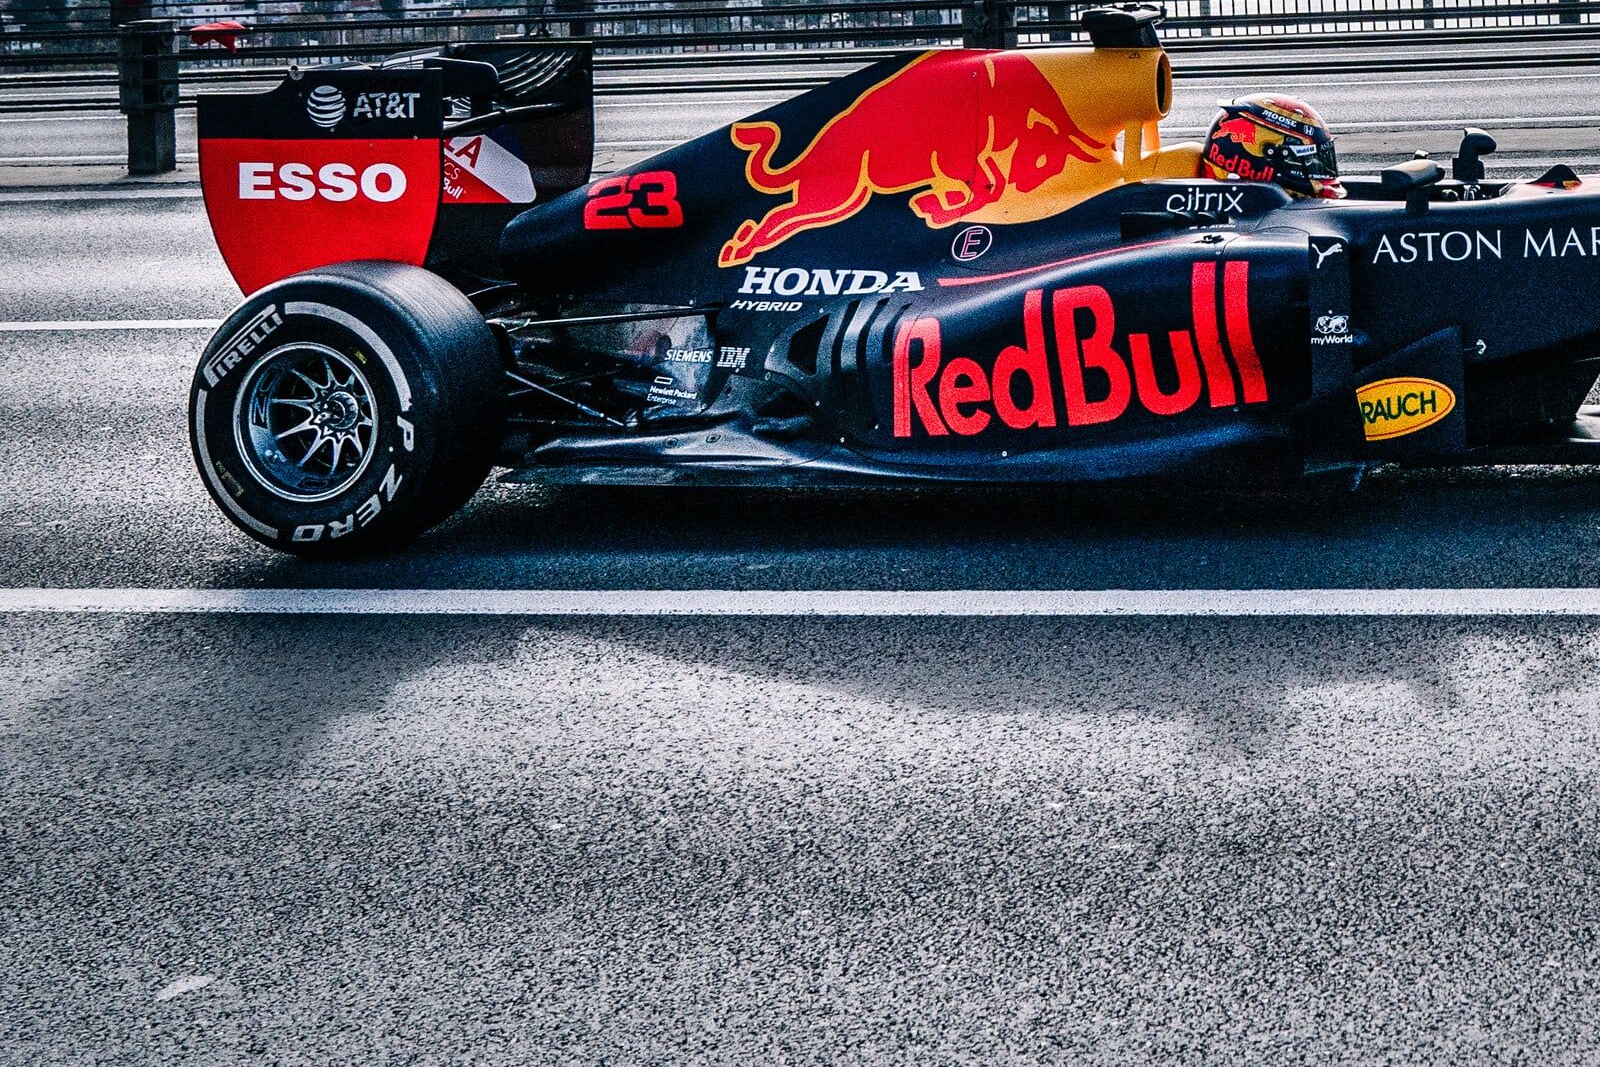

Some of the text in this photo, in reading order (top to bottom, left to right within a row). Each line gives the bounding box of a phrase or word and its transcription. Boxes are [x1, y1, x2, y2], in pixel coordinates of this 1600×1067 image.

[353, 92, 420, 119] AT&T
[1261, 110, 1298, 128] MOOSE
[238, 162, 407, 202] ESSO
[583, 171, 684, 229] 23
[1166, 186, 1244, 212] citrix
[1372, 230, 1502, 264] ASTON
[737, 266, 925, 296] HONDA
[730, 299, 803, 312] HYBRID
[202, 303, 284, 388] PIRELLI
[1310, 334, 1353, 346] myWorld
[664, 349, 714, 363] SIEMENS
[716, 346, 751, 368] IBM
[646, 393, 677, 406] Enterprise
[649, 385, 698, 400] Hewlett Packard
[1360, 390, 1437, 424] RAUCH
[291, 415, 414, 542] P ZERO
